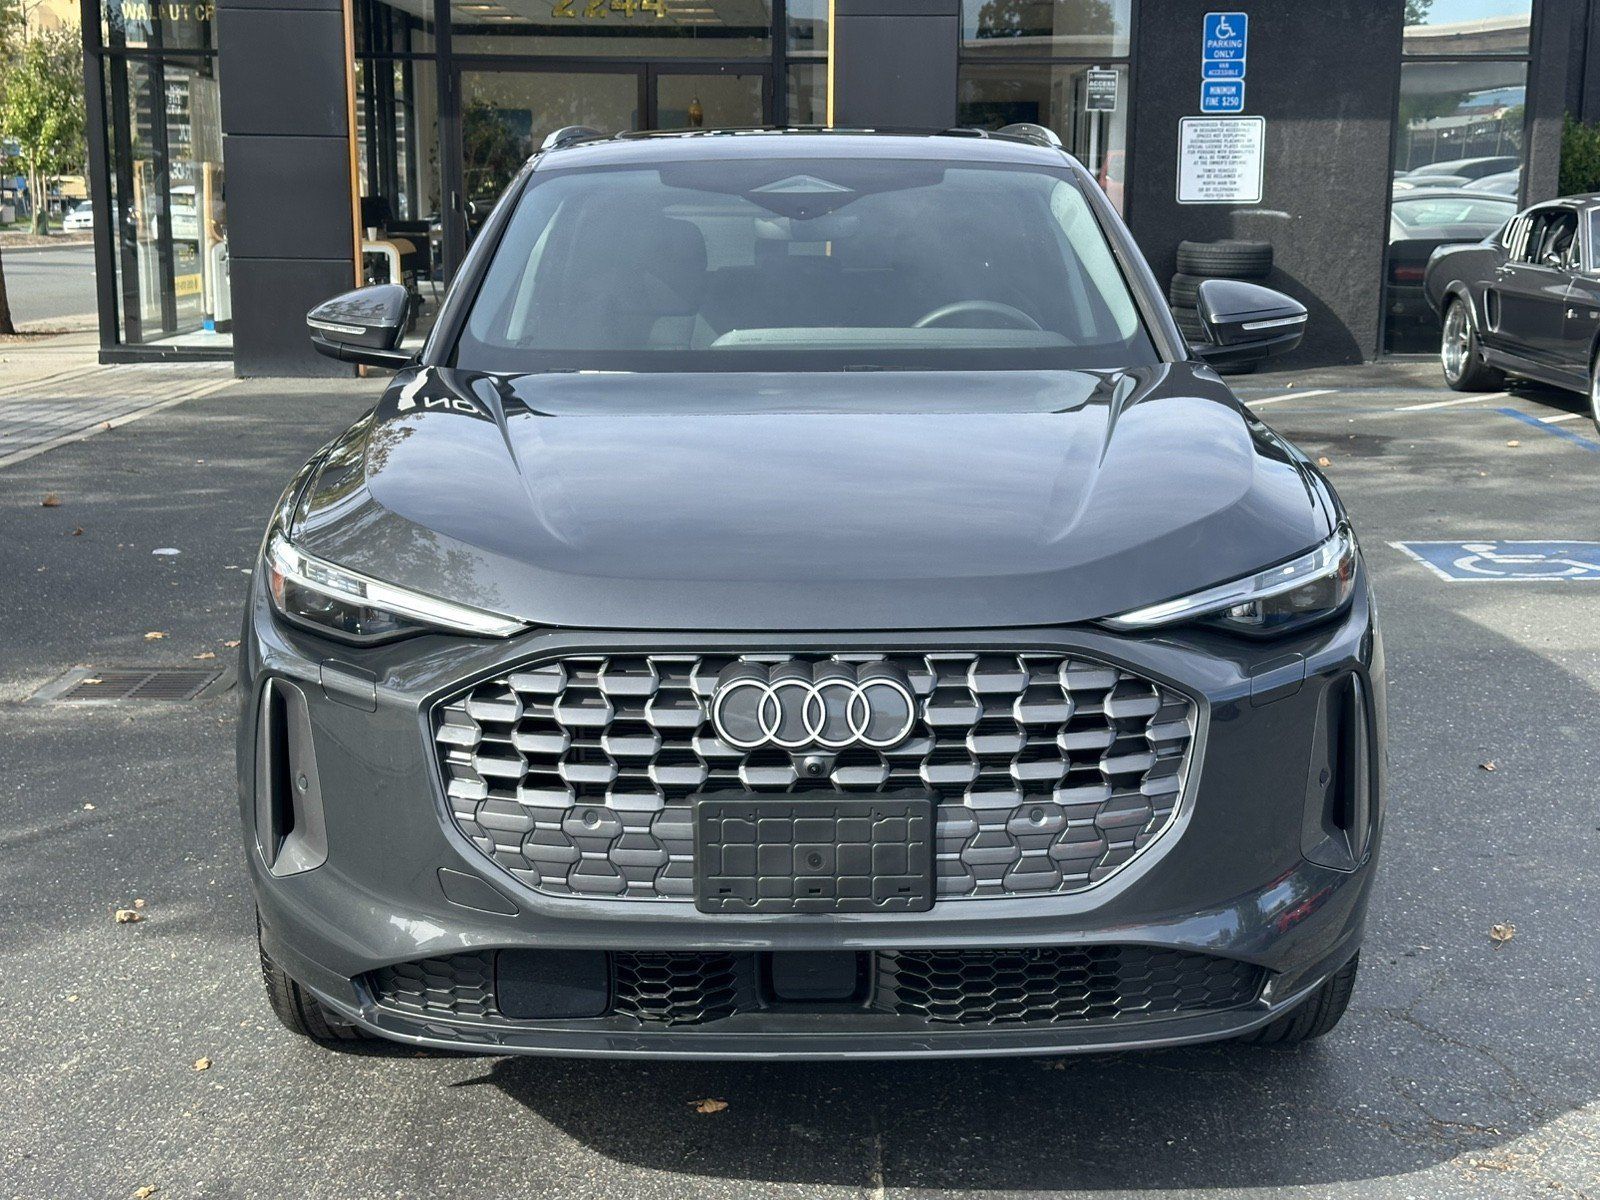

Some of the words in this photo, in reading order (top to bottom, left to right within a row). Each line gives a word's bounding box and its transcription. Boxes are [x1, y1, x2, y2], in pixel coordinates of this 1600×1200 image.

[1207, 40, 1242, 48] PARKING
[1213, 50, 1235, 58] ONLY
[1209, 86, 1236, 95] MINIMUM
[1205, 96, 1219, 106] FINE
[1222, 96, 1239, 106] $250
